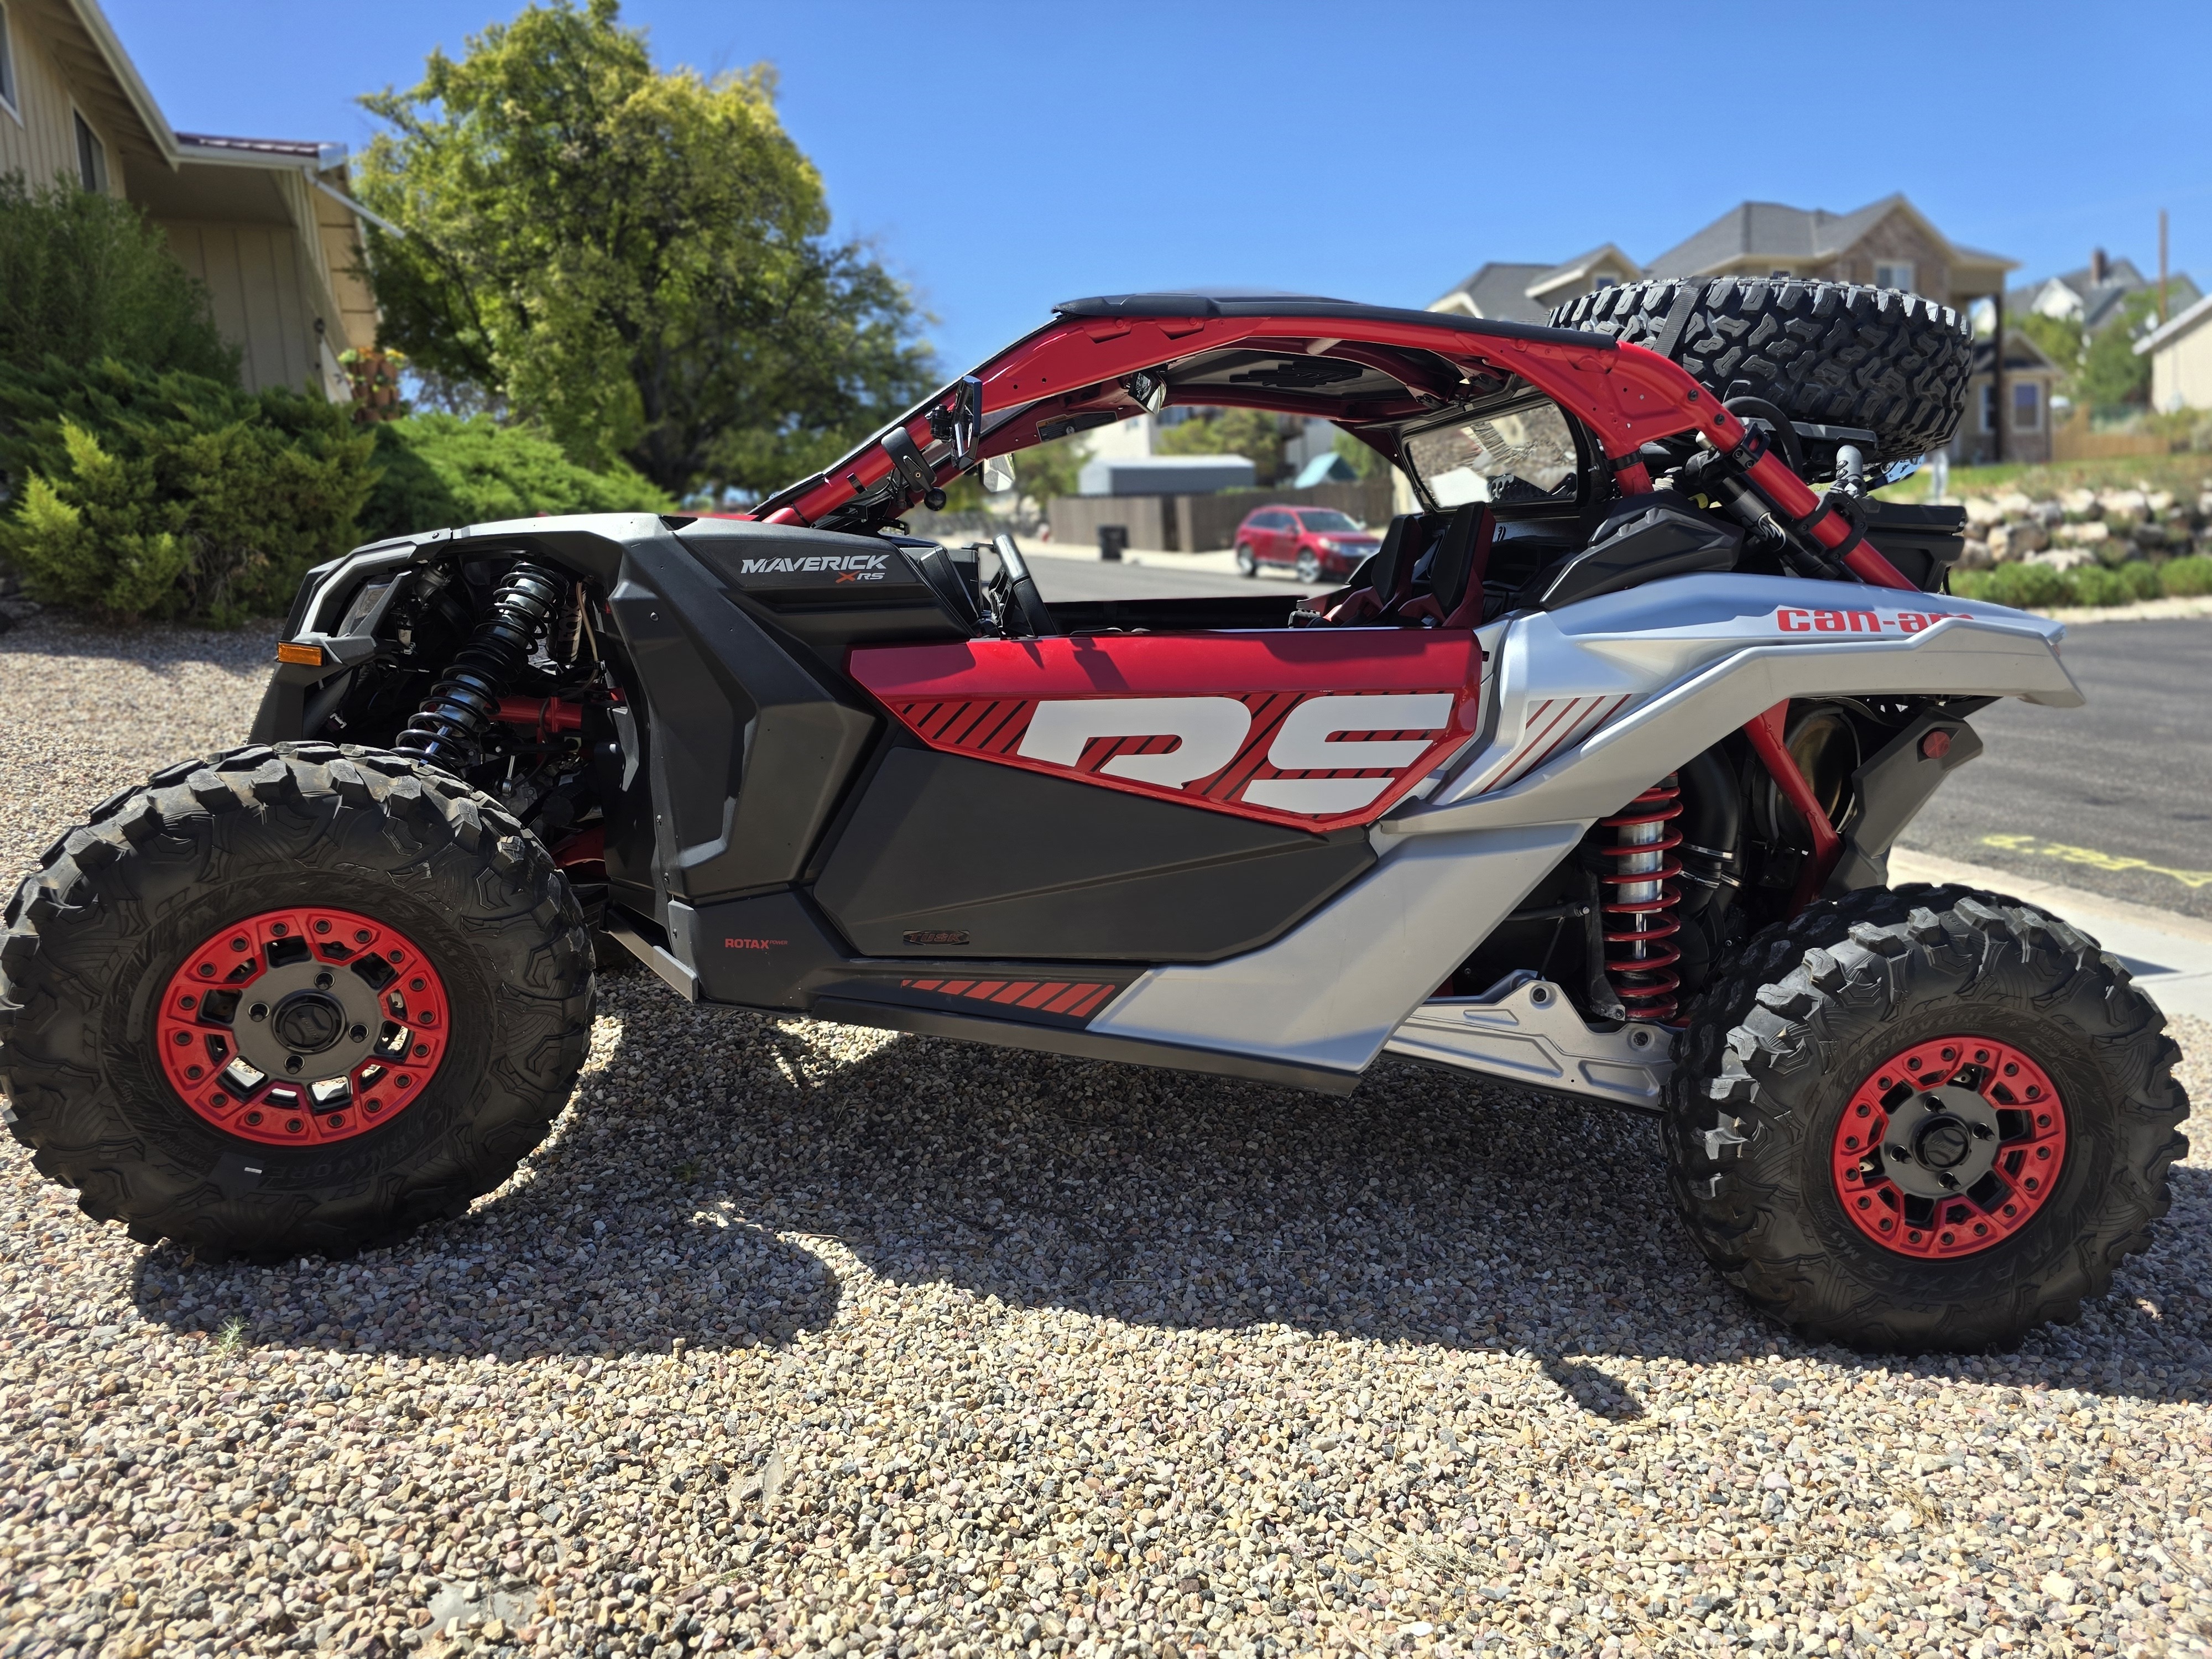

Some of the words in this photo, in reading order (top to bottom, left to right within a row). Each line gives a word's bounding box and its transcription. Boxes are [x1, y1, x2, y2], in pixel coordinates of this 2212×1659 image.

[740, 555, 890, 573] MAVERICK
[557, 603, 582, 641] FOX
[725, 938, 769, 950] ROTAX
[909, 933, 964, 942] TUSK
